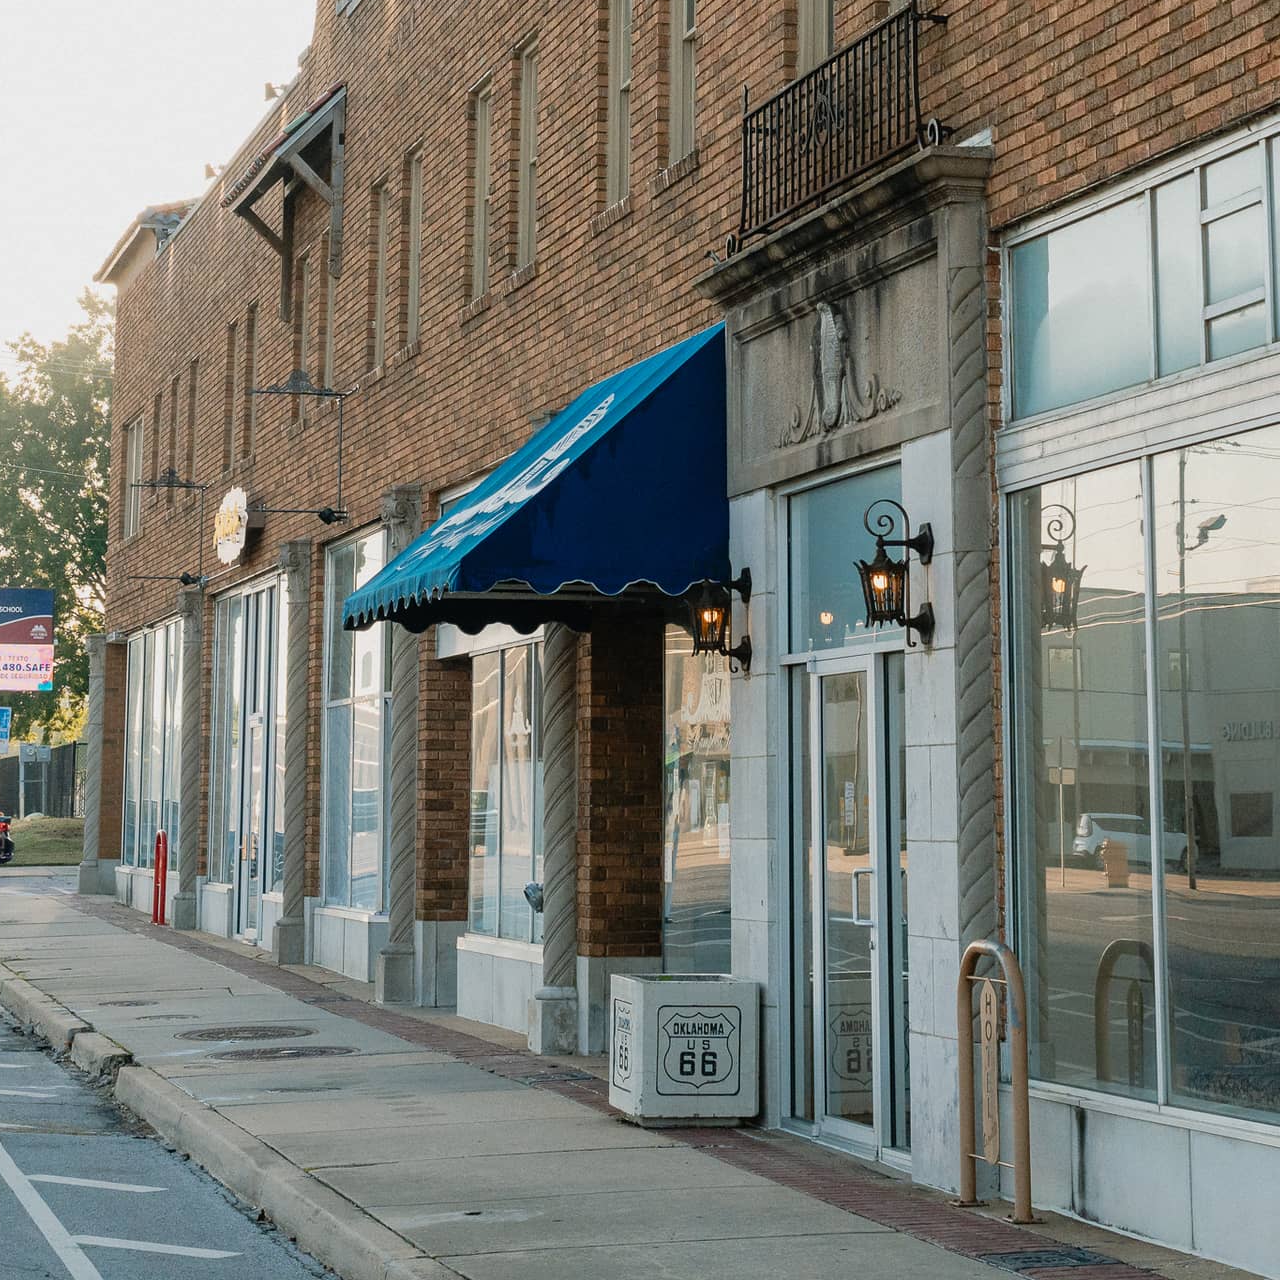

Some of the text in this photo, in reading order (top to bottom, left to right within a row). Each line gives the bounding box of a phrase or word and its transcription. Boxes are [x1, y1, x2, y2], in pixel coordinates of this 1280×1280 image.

[673, 1022, 725, 1035] OKLAHOMA
[619, 1045, 629, 1071] 66
[679, 1051, 717, 1077] 66
[984, 992, 993, 1120] HOTEL
